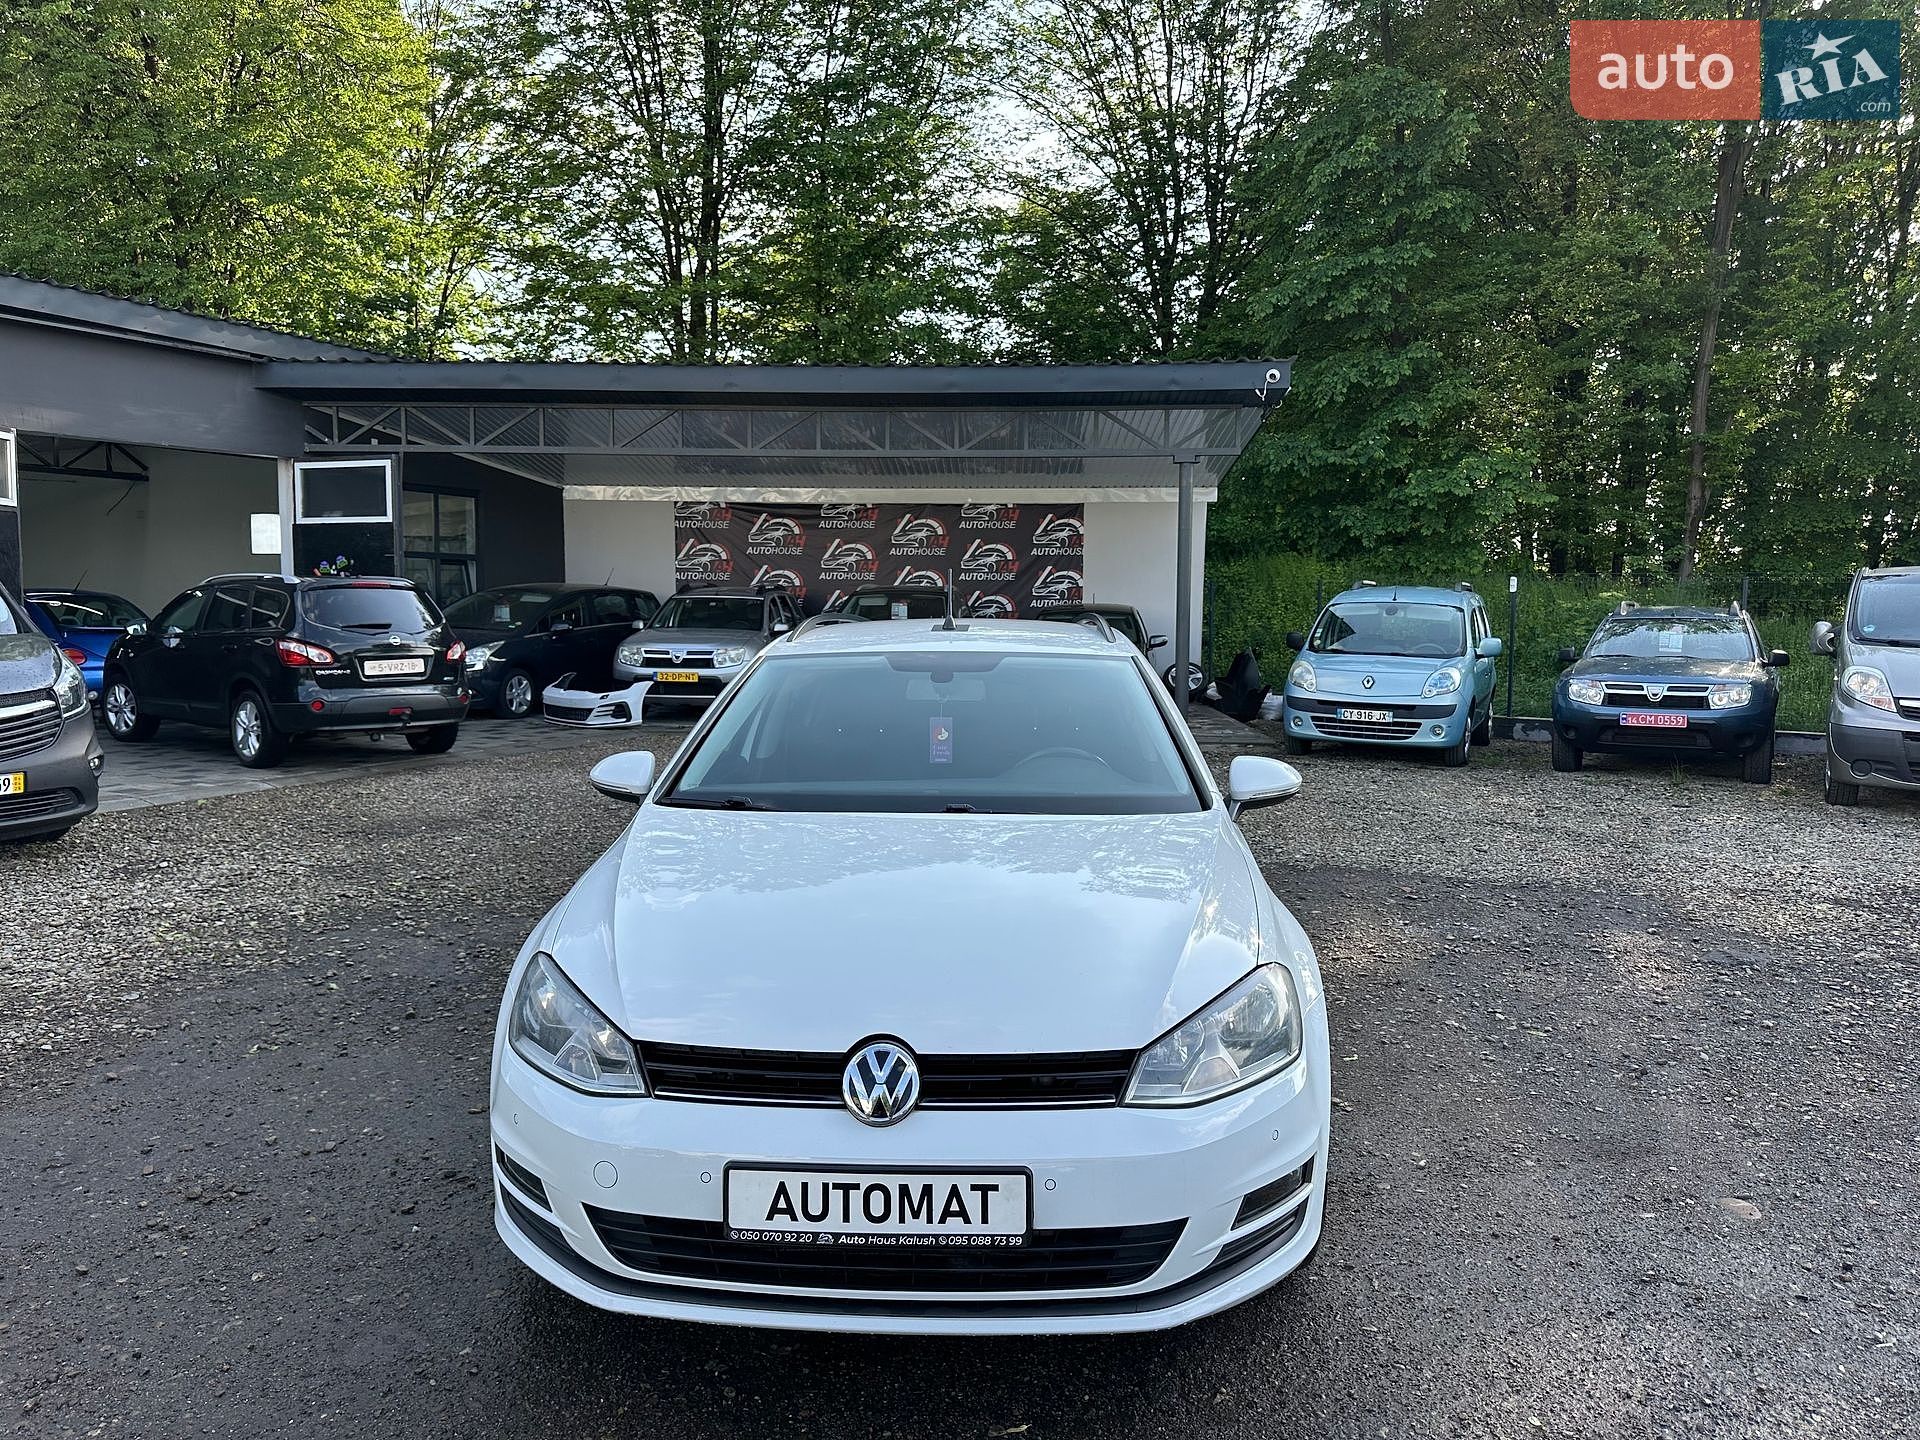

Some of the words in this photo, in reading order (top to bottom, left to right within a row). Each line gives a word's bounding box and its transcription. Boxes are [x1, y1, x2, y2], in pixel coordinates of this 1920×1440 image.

[819, 520, 876, 529] AUTOHOUSE
[959, 520, 1017, 529] AUTOHOUSE
[746, 546, 803, 555] AUTOHOUSE
[889, 548, 947, 556] AUTOHOUSE
[1031, 547, 1084, 556] AUTOHOUS
[675, 572, 731, 581] AUTOHOUSE
[819, 572, 876, 581] AUTOHOUSE
[959, 573, 1016, 581] AUTOHOUSE
[1342, 709, 1354, 719] CY
[1356, 710, 1373, 720] 916
[1376, 711, 1387, 721] JX
[1639, 715, 1655, 725] CM
[1657, 715, 1683, 726] 0559
[0, 777, 10, 792] 9
[765, 1180, 999, 1225] AUTOMAT
[739, 1230, 760, 1241] 050
[762, 1231, 782, 1242] 070
[784, 1232, 797, 1243] 92
[798, 1233, 813, 1243] 20
[838, 1234, 866, 1245] Auto
[868, 1235, 896, 1245] Haus
[898, 1235, 936, 1246] Kalush
[948, 1236, 968, 1246] 095
[970, 1236, 992, 1246] 088
[994, 1236, 1007, 1246] 73
[1008, 1236, 1023, 1246] 99
